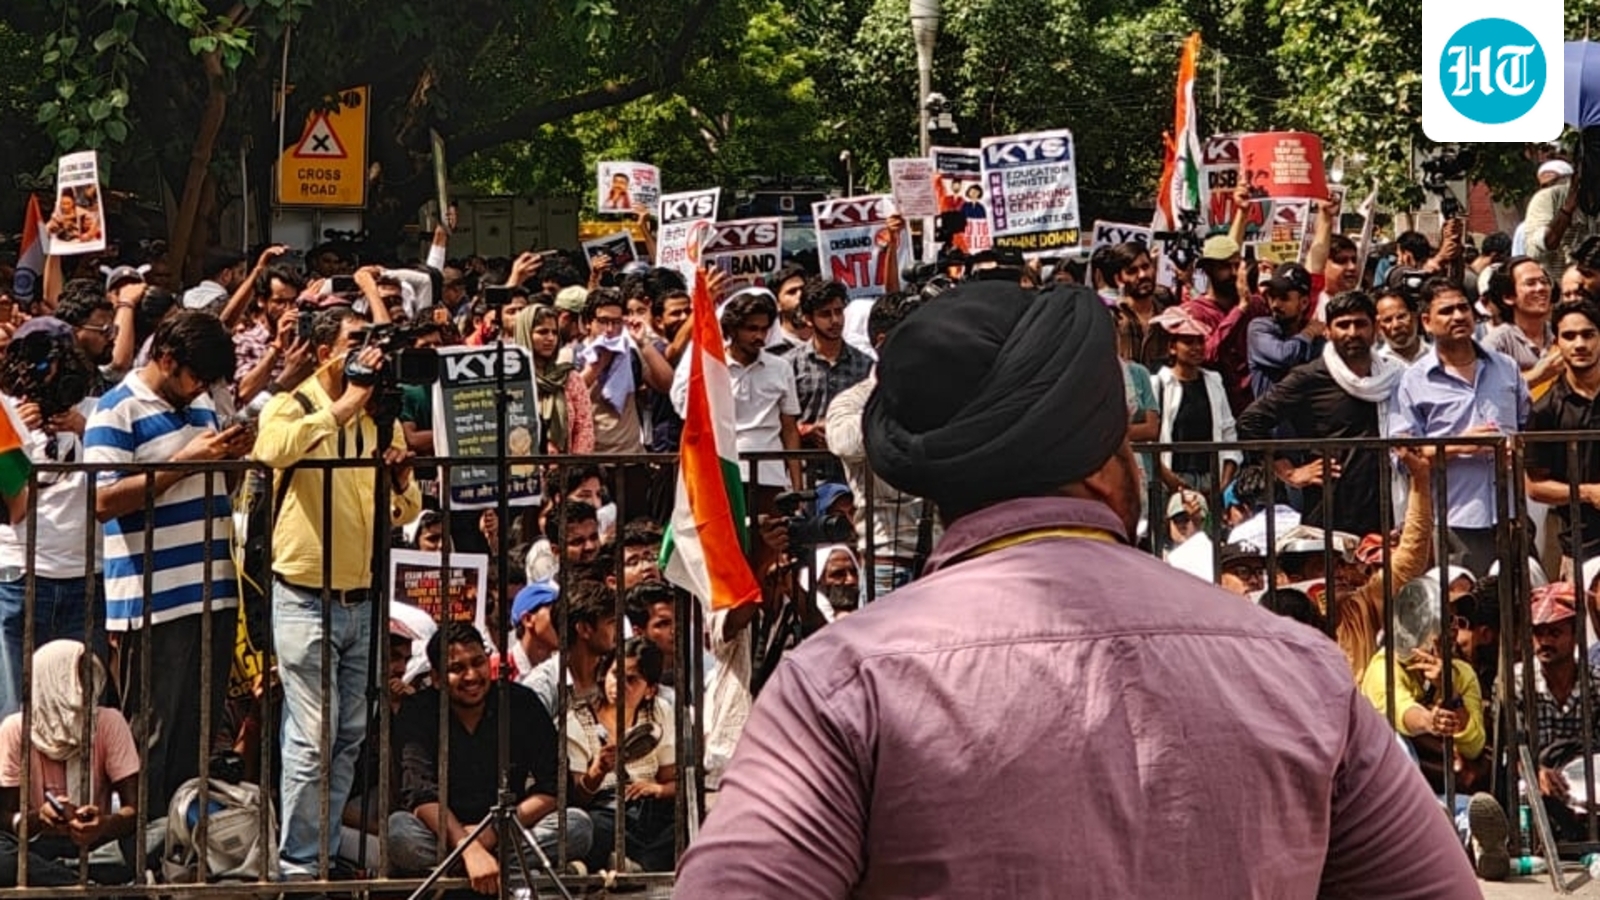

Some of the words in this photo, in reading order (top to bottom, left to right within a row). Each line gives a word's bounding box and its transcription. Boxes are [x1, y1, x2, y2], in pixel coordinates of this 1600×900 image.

[988, 139, 1066, 165] KYS
[297, 167, 341, 181] CROSS
[1006, 165, 1069, 180] EDUCATION
[1208, 170, 1238, 189] DISB
[300, 182, 337, 196] ROAD
[1008, 187, 1071, 203] COACHING
[664, 193, 713, 217] KYS
[1009, 199, 1064, 213] CENTRES
[1010, 213, 1074, 228] SCAMSTERS
[1039, 230, 1077, 247] DOWN!
[446, 351, 522, 380] KYS
